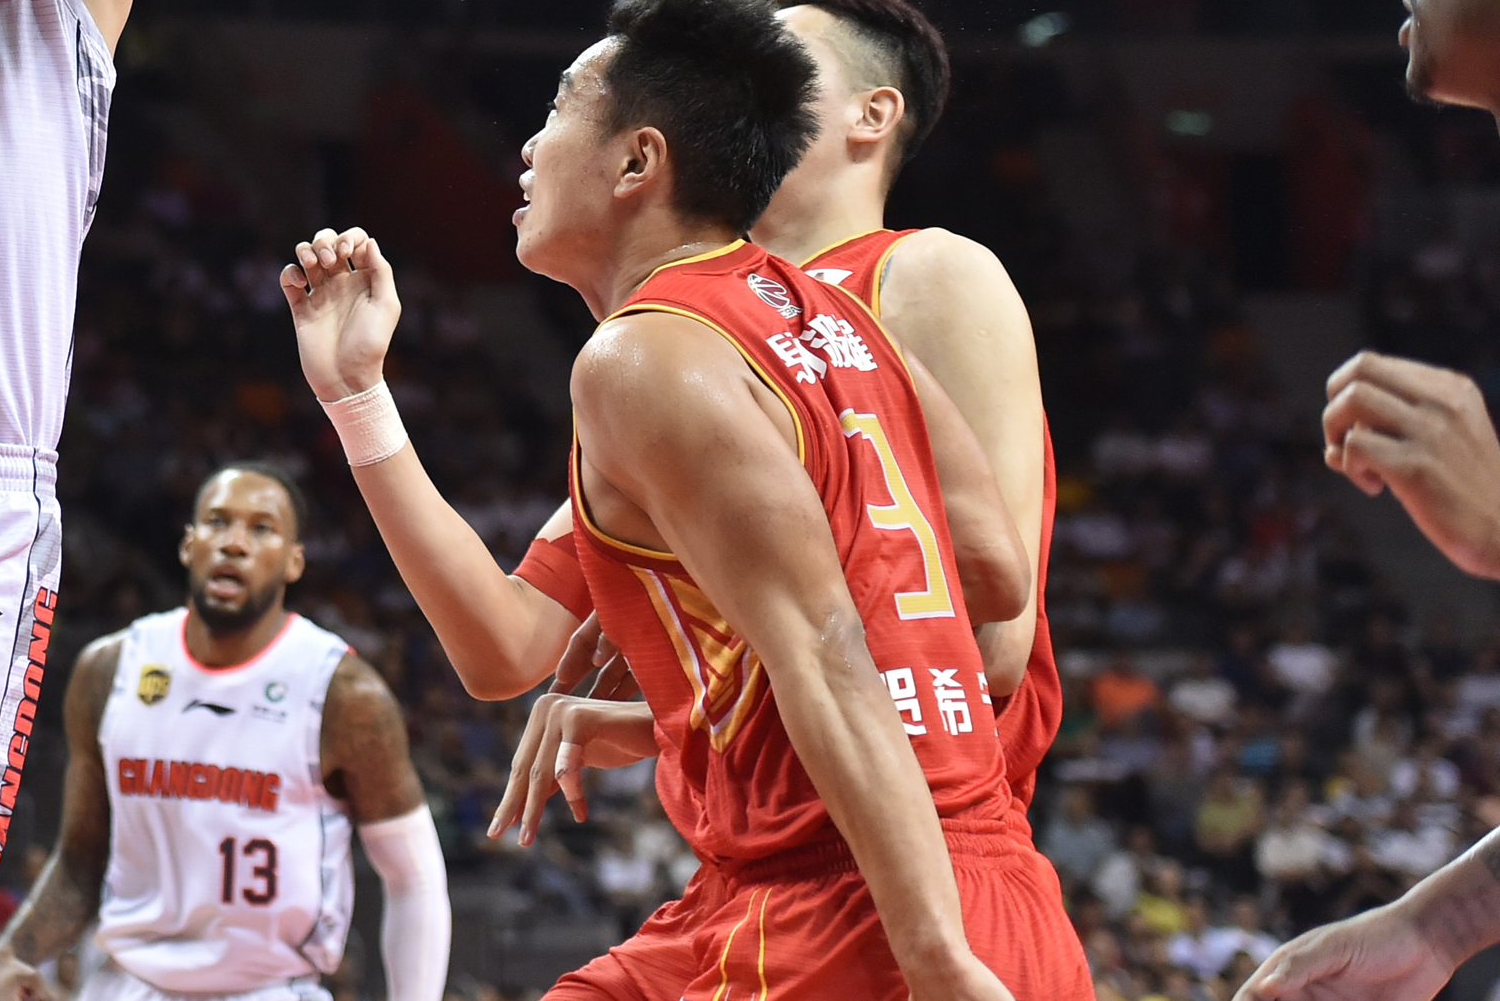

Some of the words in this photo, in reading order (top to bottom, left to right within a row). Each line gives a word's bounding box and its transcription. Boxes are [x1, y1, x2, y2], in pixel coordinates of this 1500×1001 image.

[838, 407, 957, 621] 3
[118, 757, 282, 812] GUANGDONG
[218, 835, 278, 907] 13
